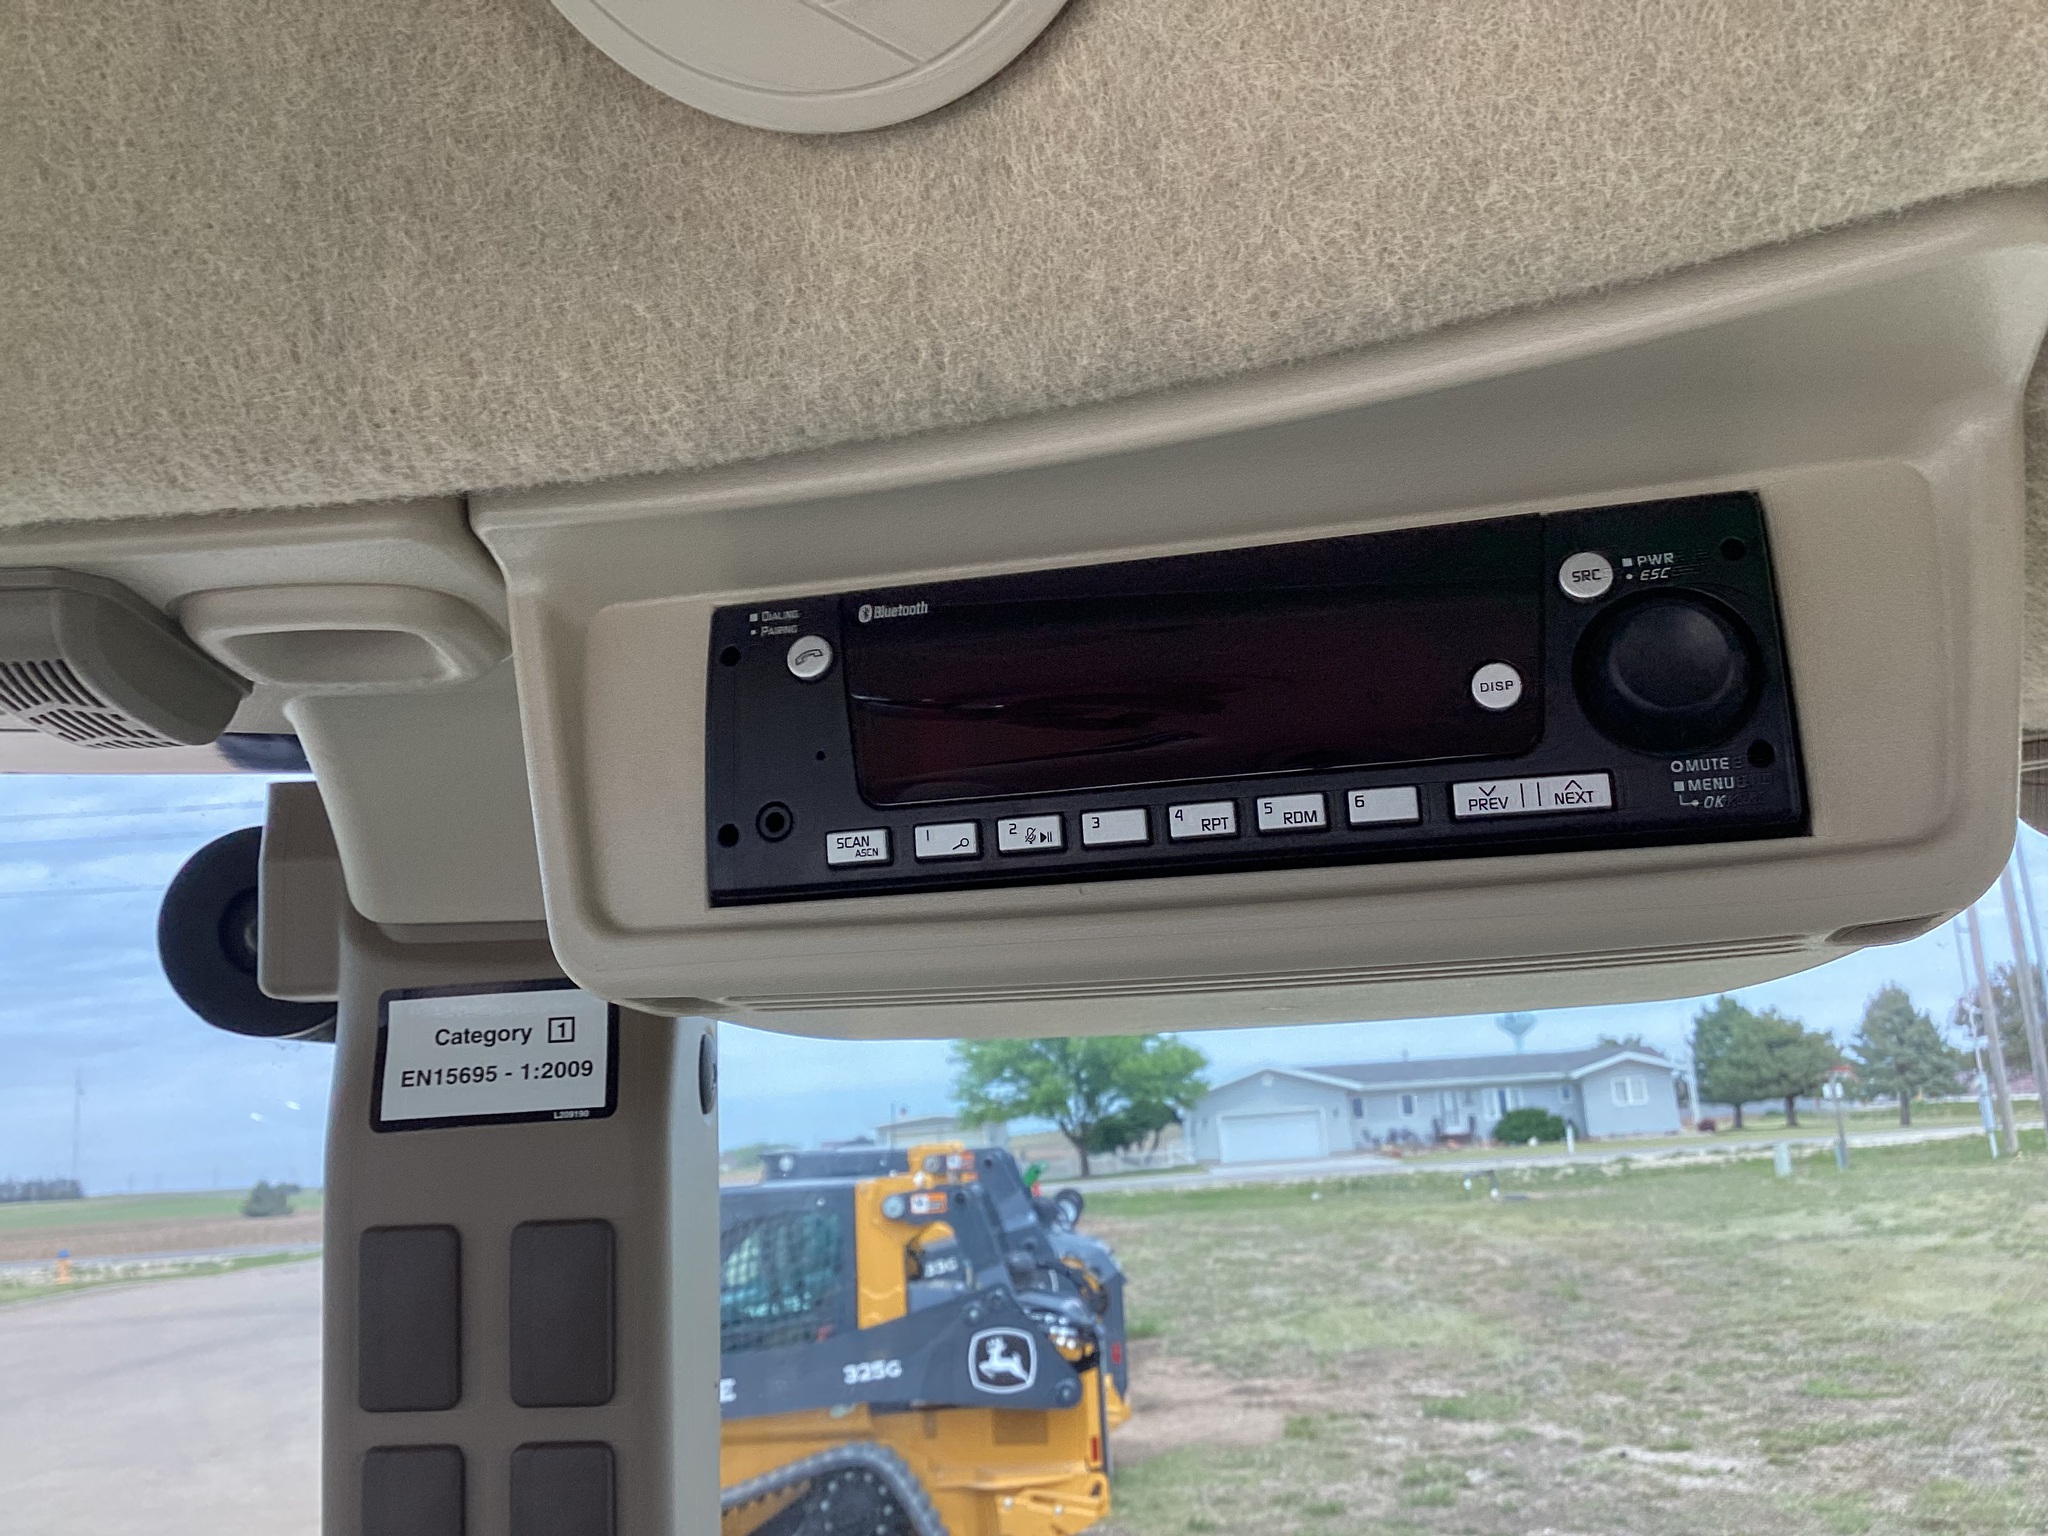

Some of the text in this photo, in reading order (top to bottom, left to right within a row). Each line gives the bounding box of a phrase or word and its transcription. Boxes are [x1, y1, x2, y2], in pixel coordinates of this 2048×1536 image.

[1637, 552, 1674, 567] PWR
[1571, 569, 1602, 583] SRC
[1639, 567, 1672, 581] ESC
[873, 600, 929, 619] Bluetooth
[1479, 680, 1514, 693] DISP
[1685, 757, 1730, 772] MUTE
[1687, 776, 1735, 792] MENU
[1354, 795, 1366, 808] 6
[1468, 796, 1509, 812] PREV
[1554, 790, 1594, 806] NEXT
[1703, 794, 1726, 809] OK
[1174, 809, 1184, 822] 4
[1263, 802, 1274, 815] 5
[1091, 817, 1101, 829] 3
[1201, 817, 1229, 832] RPT
[1282, 809, 1318, 825] RDM
[1008, 823, 1018, 835] 2
[836, 835, 870, 849] SCAN
[854, 847, 879, 858] ASCN
[434, 1027, 533, 1048] Category
[401, 1065, 498, 1088] EN15695
[520, 1060, 594, 1081] 1:2009
